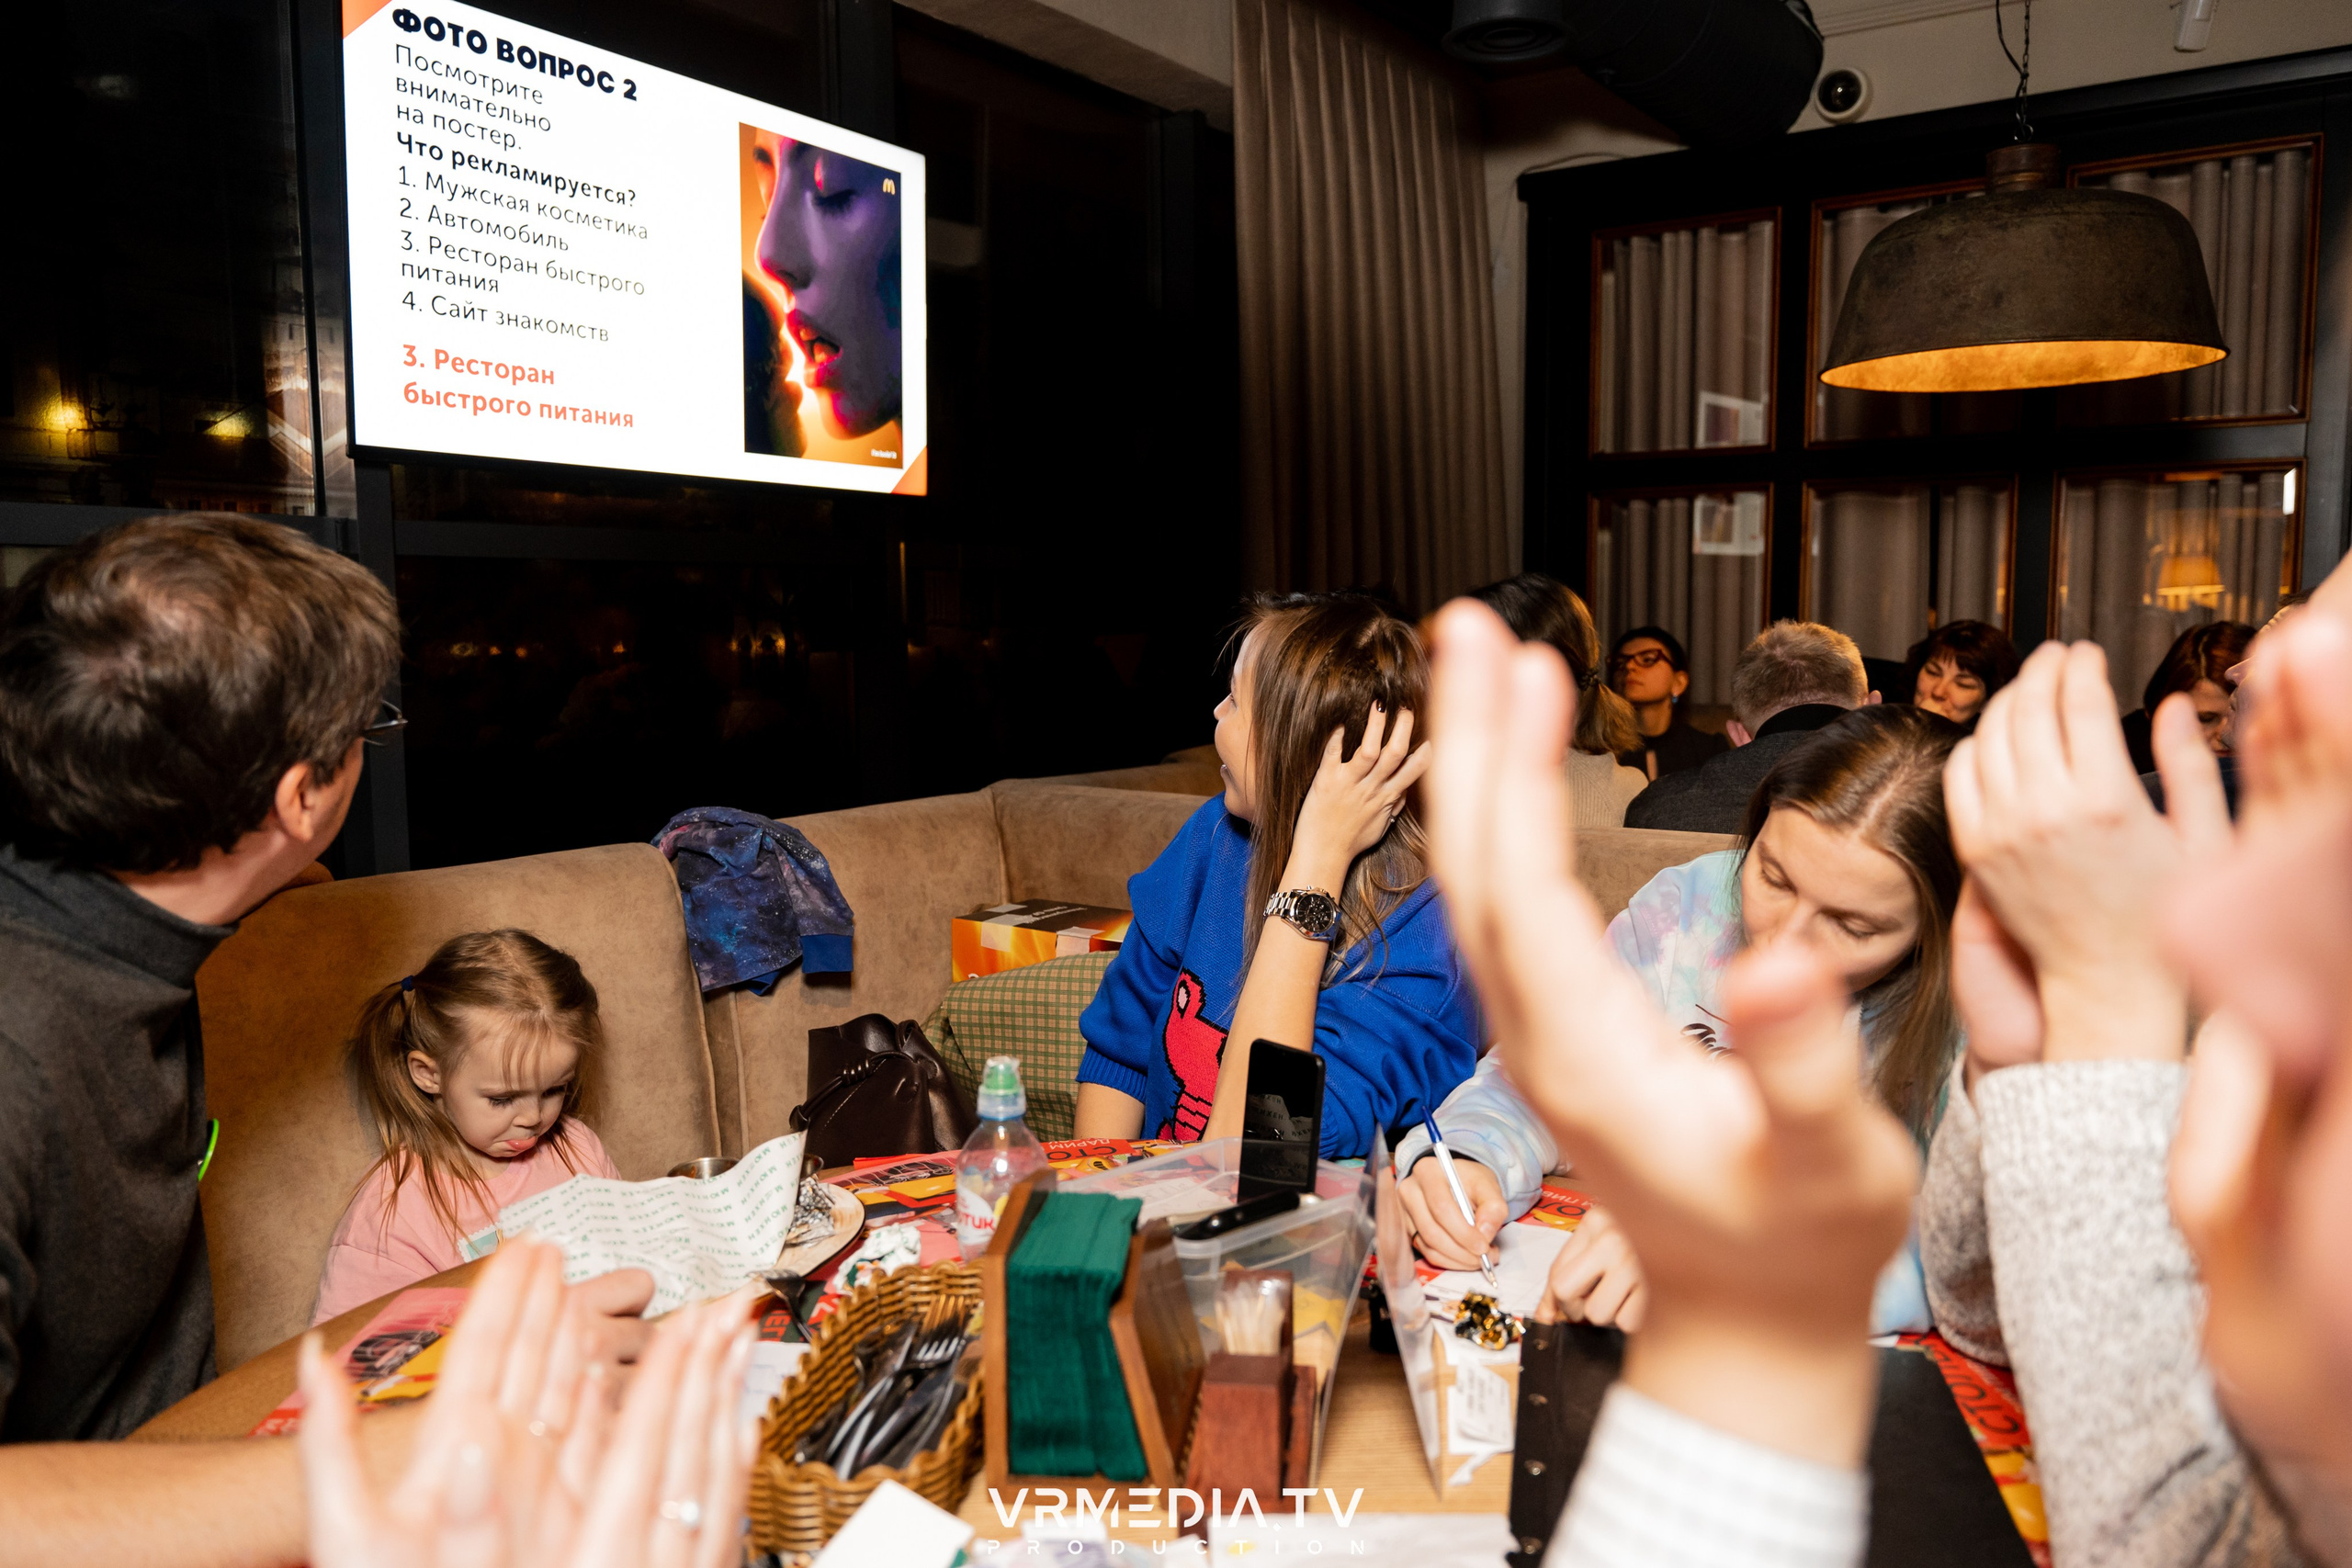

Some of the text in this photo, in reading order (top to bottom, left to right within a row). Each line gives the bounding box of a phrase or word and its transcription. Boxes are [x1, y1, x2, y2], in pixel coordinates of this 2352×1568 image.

[392, 8, 638, 101] ФОТО ВОПРОС 2
[395, 44, 543, 105] Посмотрите
[396, 77, 551, 131] внимательно
[397, 105, 522, 152] на постер.
[397, 131, 636, 207] Что рекламируется?
[399, 165, 648, 240] 1. Мужская косметика
[400, 198, 569, 252] 2. Автомобиль
[401, 231, 645, 296] 3. Ресторан быстрого
[401, 263, 499, 293] питания
[402, 291, 609, 342] 4. Сайт знакомств
[402, 344, 555, 386] 3. Ресторан
[403, 382, 634, 428] быстрого питания
[1046, 1145, 1117, 1161] СТО
